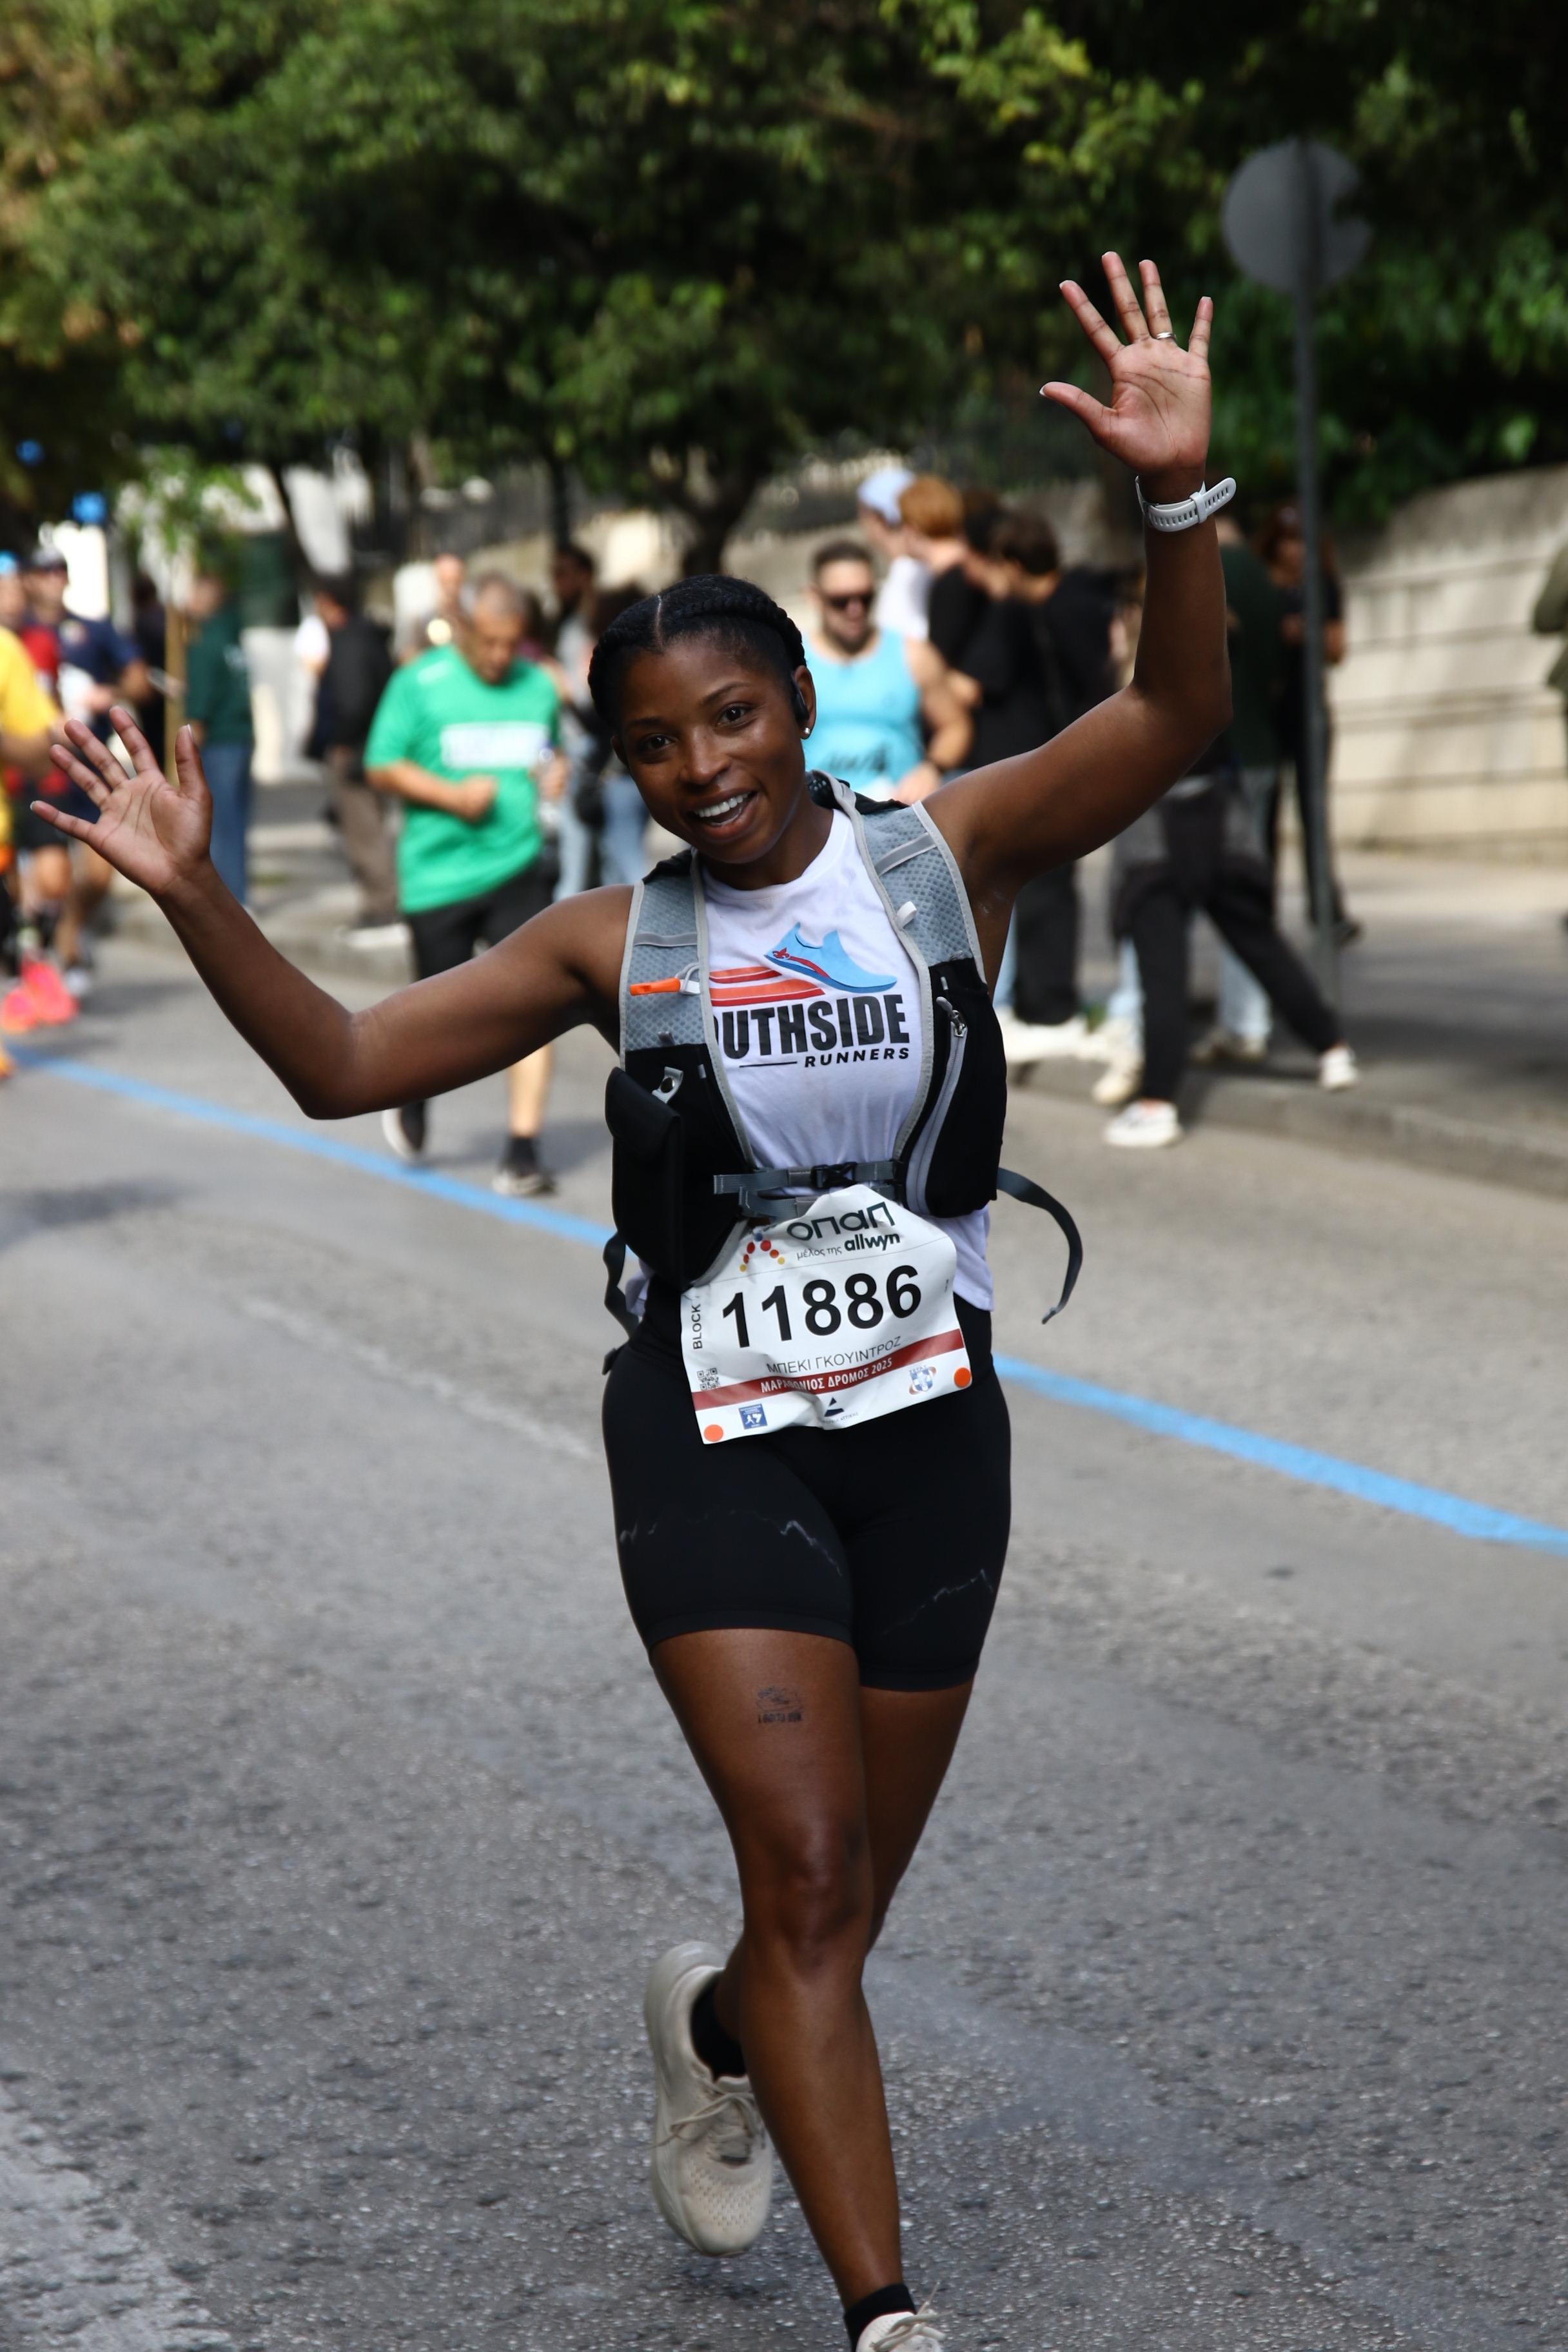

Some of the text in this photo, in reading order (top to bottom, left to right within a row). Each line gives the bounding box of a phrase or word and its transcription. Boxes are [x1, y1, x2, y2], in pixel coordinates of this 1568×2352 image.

[713, 994, 910, 1059] UTHSIDE
[805, 1048, 909, 1068] RUNNERS
[796, 1233, 900, 1260] μέλος της allwyn
[723, 1265, 921, 1348] 11886
[691, 1304, 703, 1349] BLOCK
[766, 1336, 901, 1374] ΜΠΕΚΙ ΓΚΟΥΙΝΤΡΟΖ
[828, 1367, 869, 1387] ΔΡΟΜΟΣ
[872, 1357, 892, 1375] 2025
